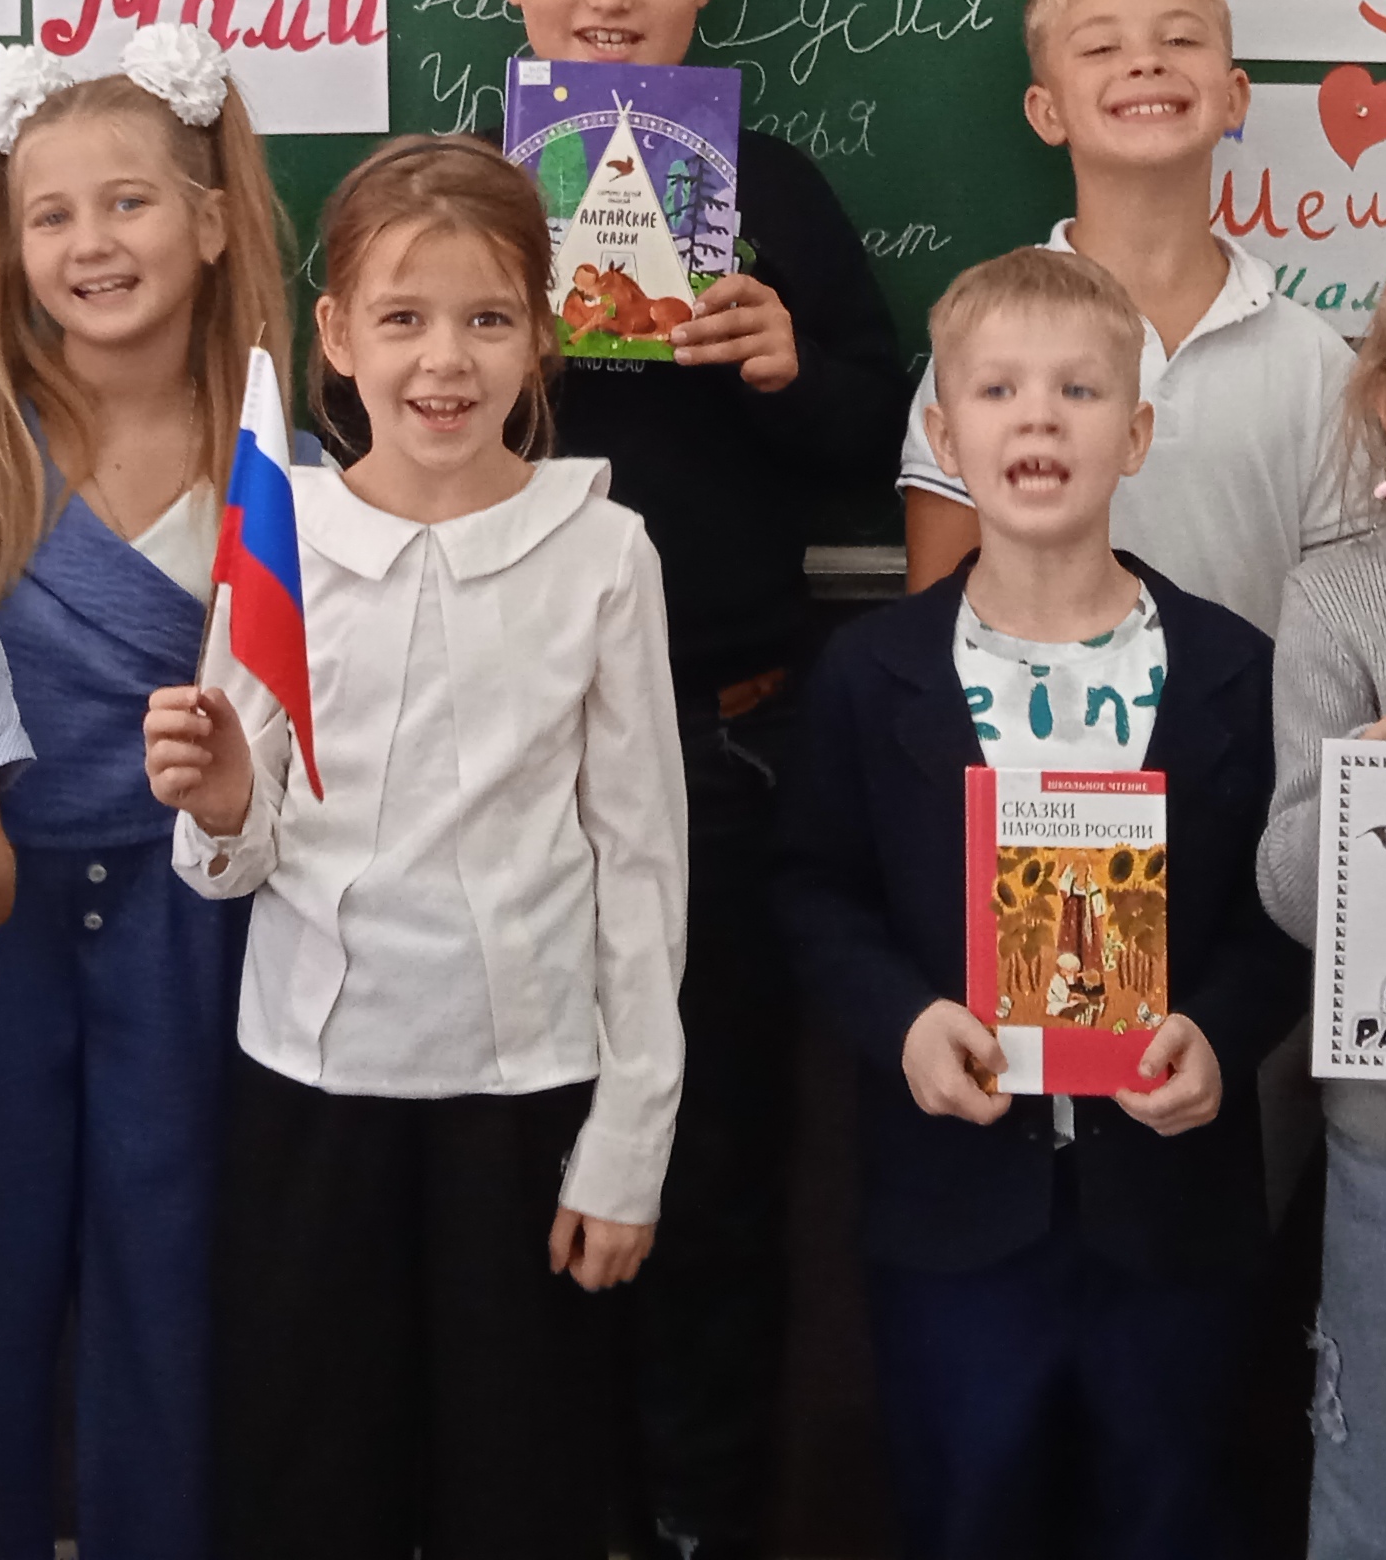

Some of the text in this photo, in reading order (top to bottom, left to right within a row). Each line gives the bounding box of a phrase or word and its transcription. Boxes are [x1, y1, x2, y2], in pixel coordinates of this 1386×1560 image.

[580, 207, 657, 229] АЛТАЙСКИЕ
[596, 232, 638, 246] СКАЗКИ
[1047, 780, 1148, 792] ШКОЛЬНОЕ ЧТЕНИЕ
[1002, 801, 1075, 819] СКАЗКИ
[1002, 822, 1154, 839] НАРОДОВ РОССИИ
